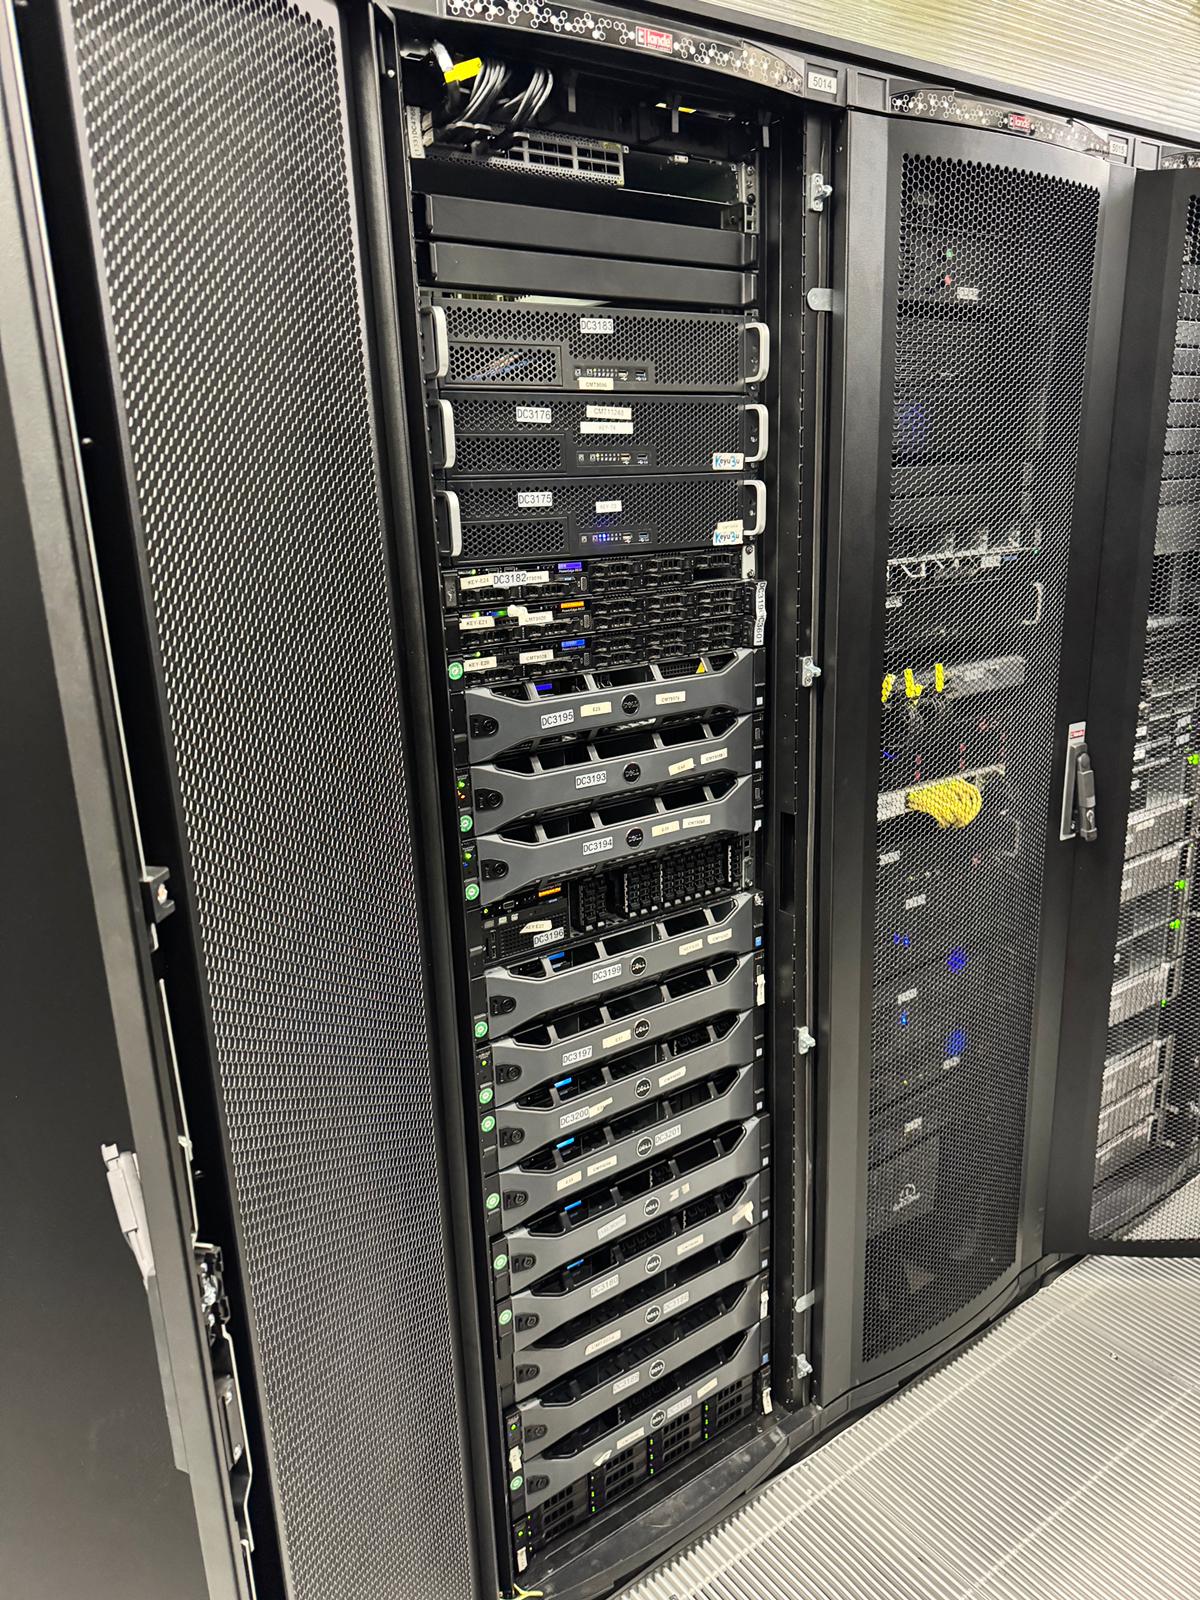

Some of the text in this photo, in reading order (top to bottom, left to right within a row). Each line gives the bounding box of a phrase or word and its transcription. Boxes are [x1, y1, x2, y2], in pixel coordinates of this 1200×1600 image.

[813, 73, 832, 89] 5014
[581, 320, 613, 331] DC3183
[517, 407, 551, 420] DC3176
[519, 494, 552, 505] DC3175
[493, 573, 527, 585] DC3182
[542, 711, 574, 726] DC3195
[576, 772, 606, 786] DC3193
[584, 838, 612, 852] DC3194
[535, 928, 564, 945] DC3196
[594, 965, 621, 981] DC3199
[563, 1047, 592, 1063] DC3197
[561, 1108, 589, 1126] DC3200
[655, 1125, 681, 1144] DC3201
